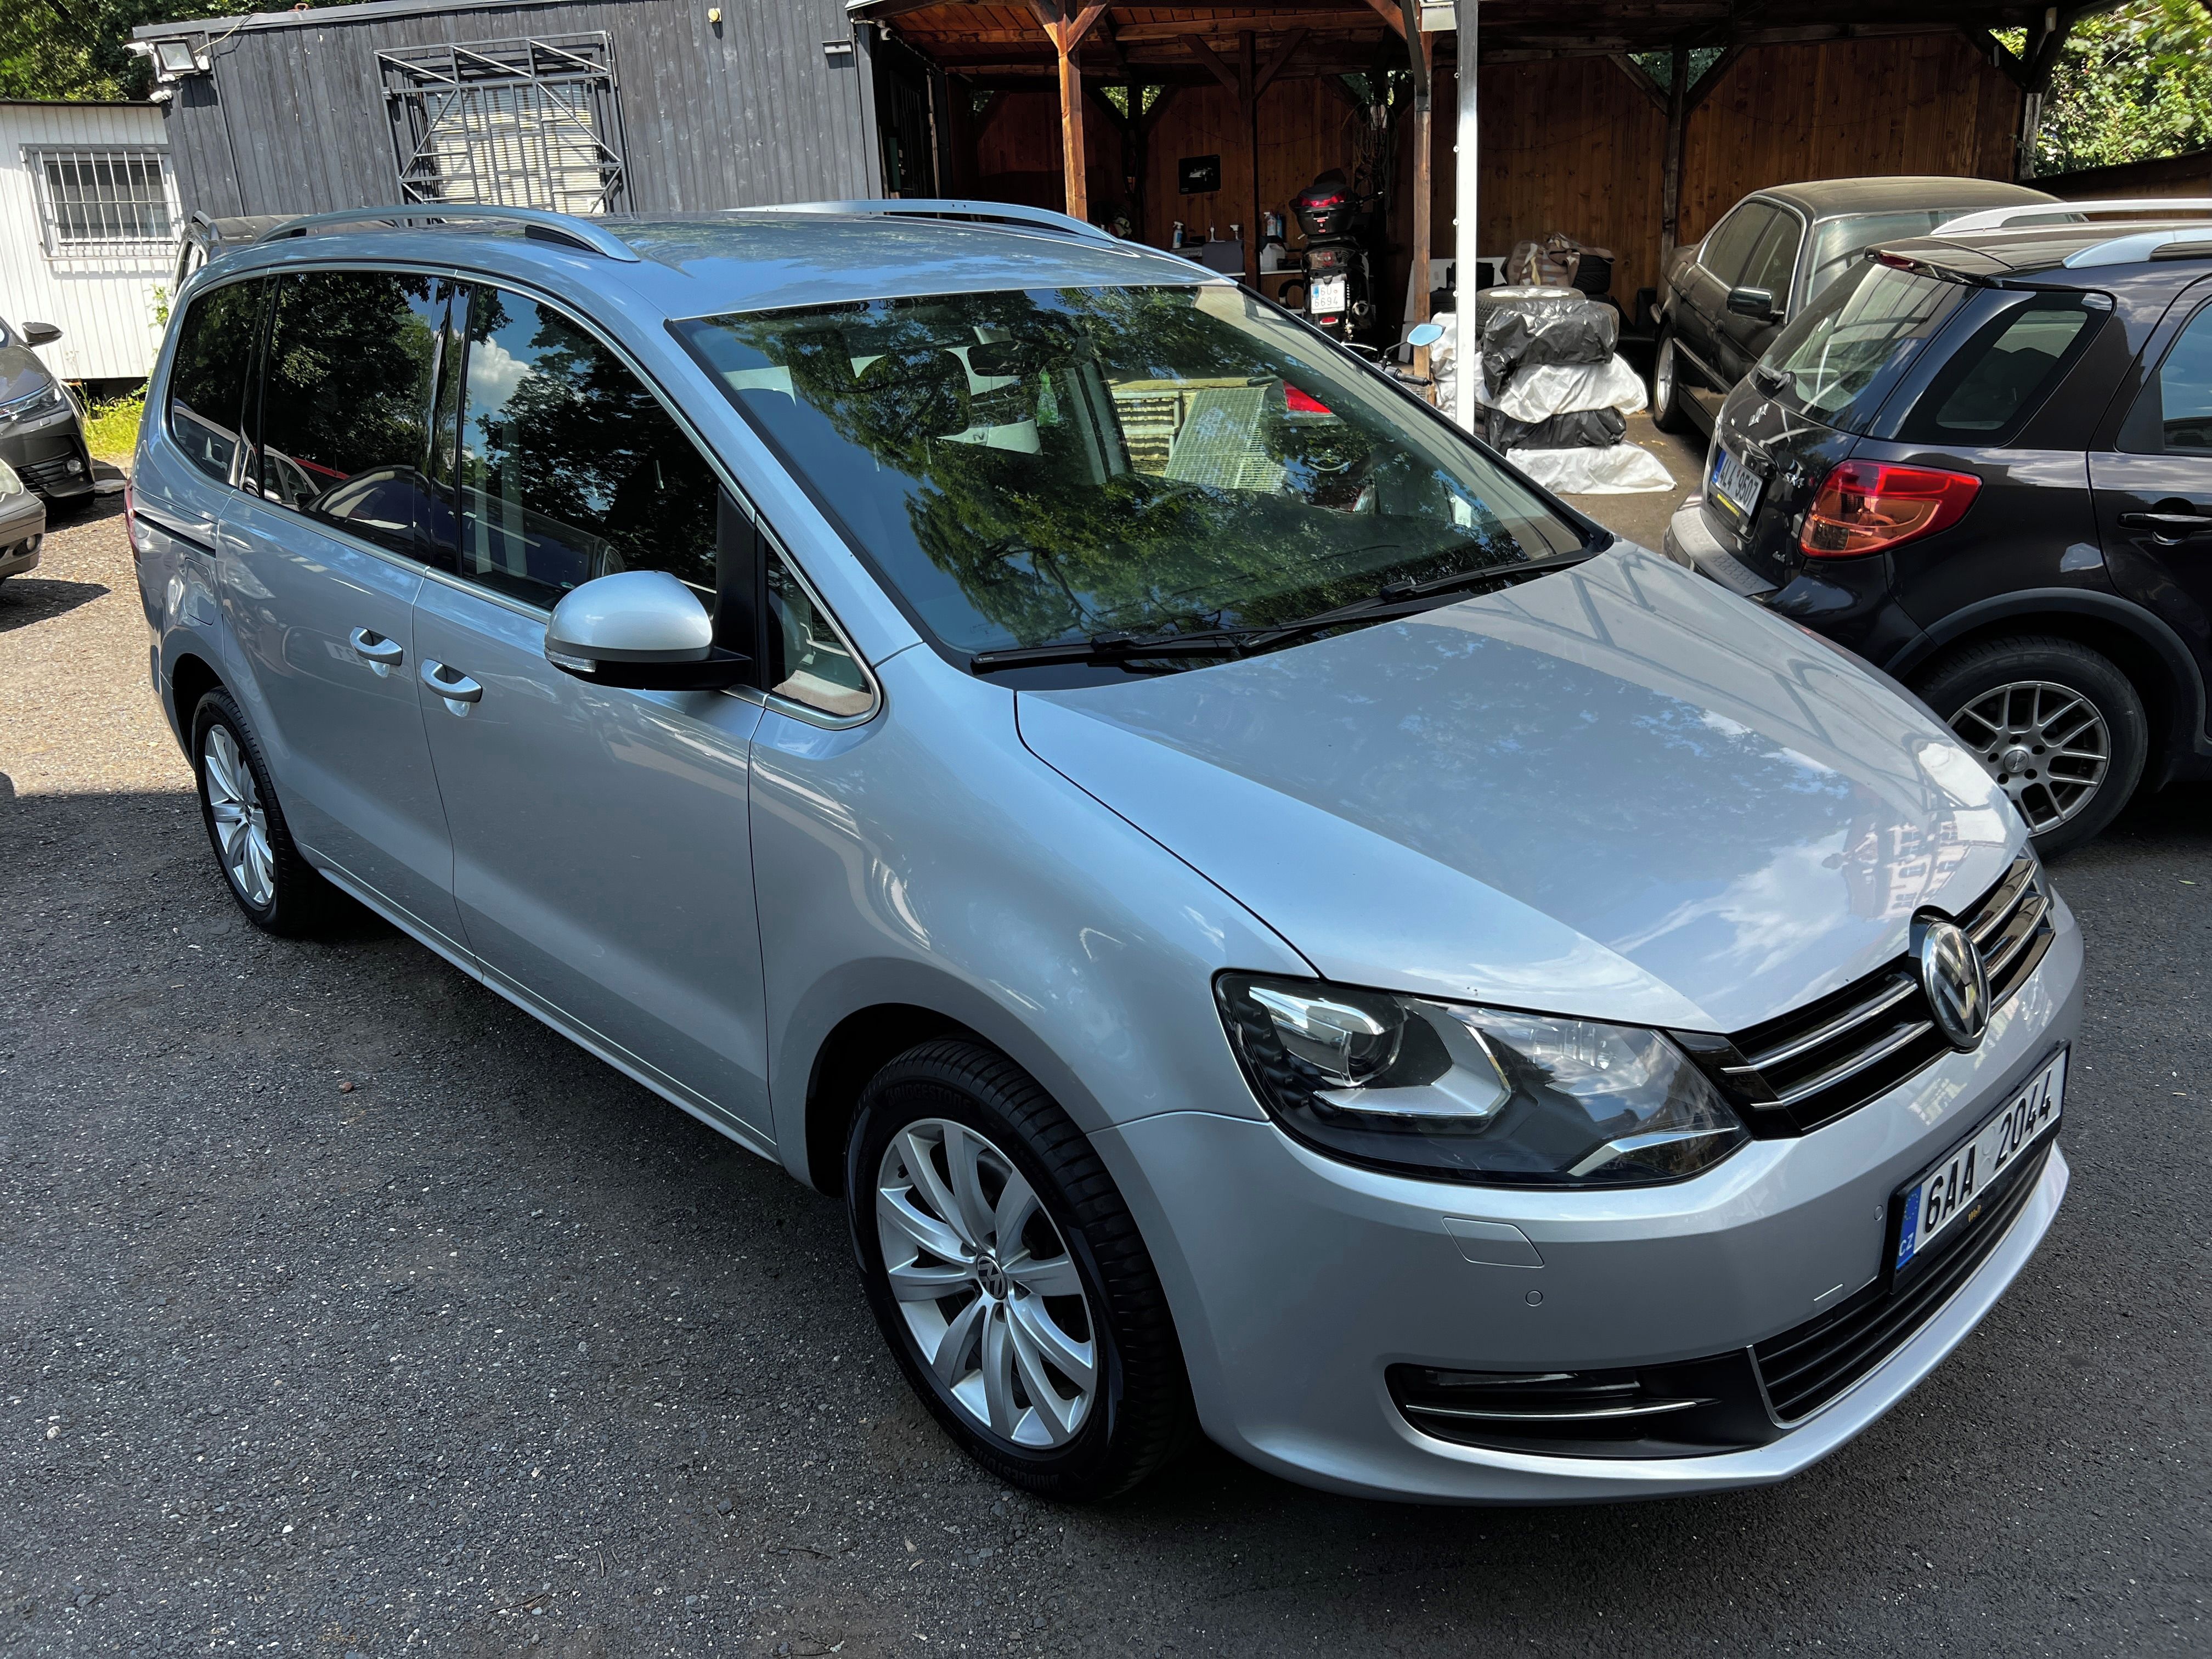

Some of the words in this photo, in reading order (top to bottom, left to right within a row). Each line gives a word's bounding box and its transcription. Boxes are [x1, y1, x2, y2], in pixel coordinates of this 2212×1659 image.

[1314, 297, 1338, 307] 6694
[1720, 458, 1736, 491] 4L4
[1735, 471, 1758, 509] 9507
[1923, 1141, 1976, 1234] 6AA
[1994, 1068, 2052, 1172] 2044
[1898, 1232, 1914, 1257] CZ
